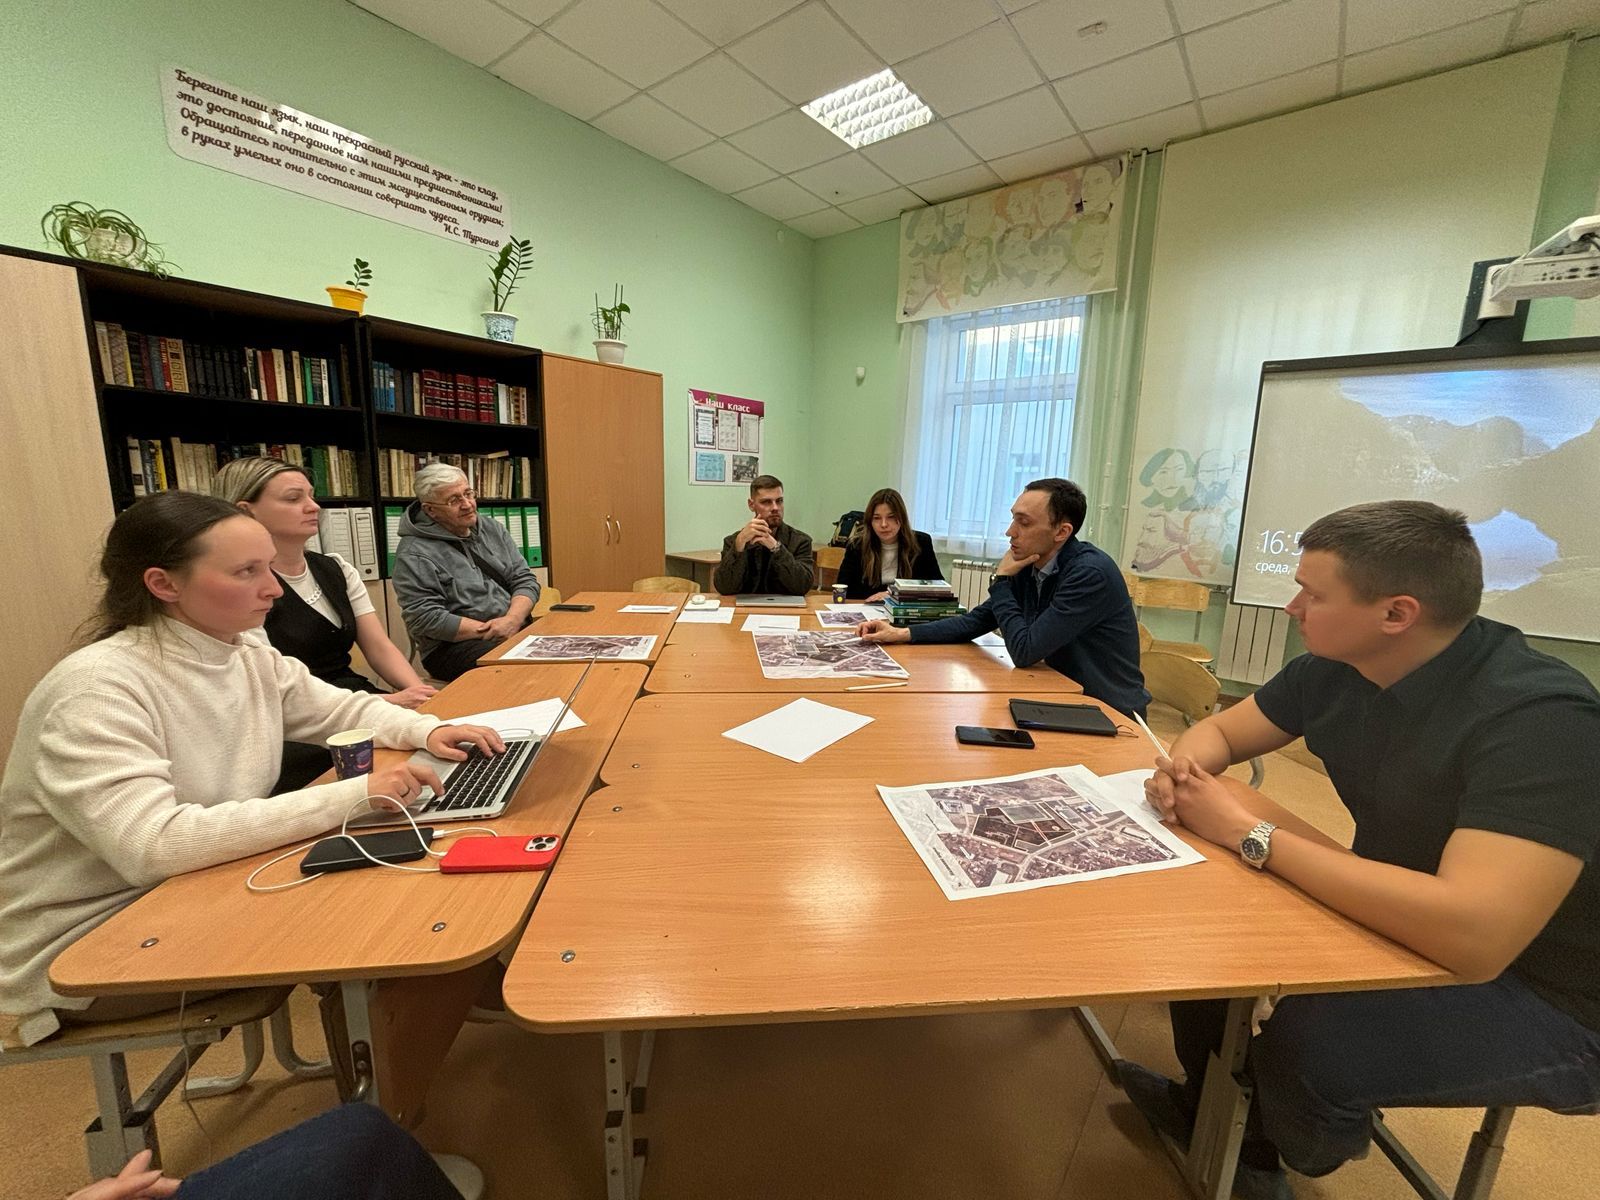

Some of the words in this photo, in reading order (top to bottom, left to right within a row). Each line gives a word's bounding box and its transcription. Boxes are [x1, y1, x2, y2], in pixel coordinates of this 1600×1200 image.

[175, 68, 238, 101] Берегите
[241, 96, 268, 113] наш
[270, 107, 302, 127] язык,
[305, 120, 330, 136] наш
[332, 130, 392, 160] прекрасный
[393, 154, 430, 174] русский
[431, 169, 452, 182] язык
[460, 180, 476, 191] это
[176, 90, 203, 107] это
[206, 100, 278, 134] достояние,
[281, 128, 344, 157] переданное
[346, 151, 369, 166] нам
[371, 161, 412, 182] нашими
[413, 176, 503, 213] предшественниками!
[180, 107, 269, 146] Обращайтесь
[272, 140, 347, 173] почтительно
[350, 167, 356, 176] с
[357, 171, 386, 187] этим
[388, 181, 467, 215] могущественным
[468, 210, 504, 227] орудием;
[181, 125, 189, 136] в
[192, 131, 231, 150] руках
[234, 143, 282, 167] умелых
[284, 161, 305, 174] оно
[307, 167, 314, 177] в
[316, 172, 374, 197] состоянии
[375, 191, 427, 214] совершать
[428, 208, 460, 225] чудеса.
[462, 229, 500, 248] Тургенев
[1255, 562, 1290, 575] среда,
[1260, 530, 1304, 556] 16:5
